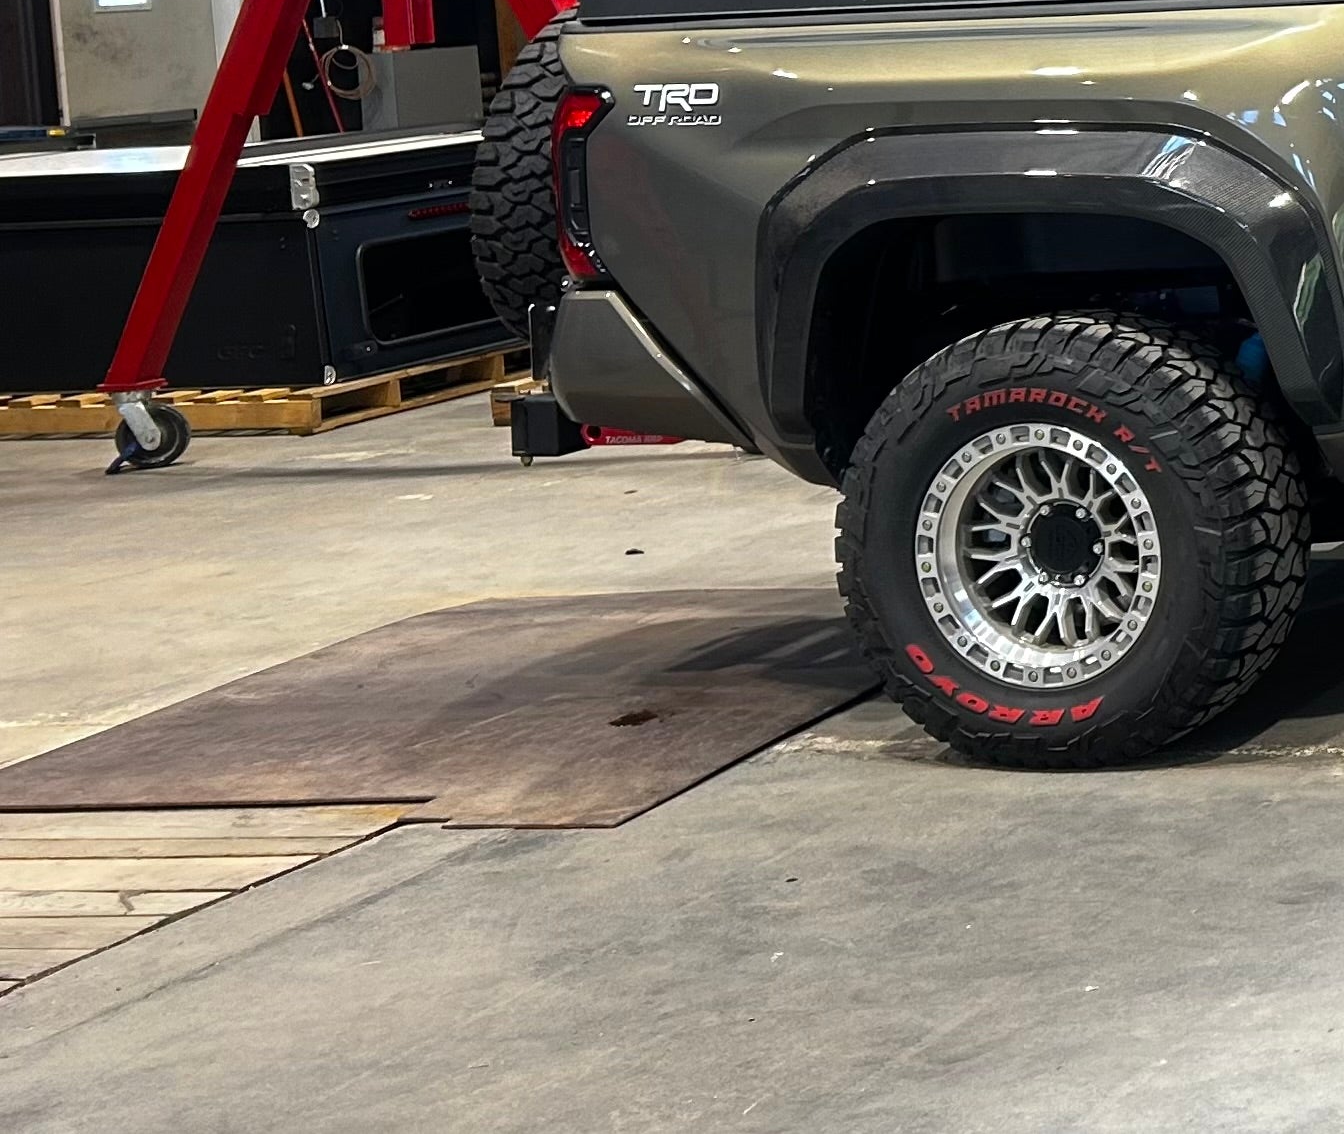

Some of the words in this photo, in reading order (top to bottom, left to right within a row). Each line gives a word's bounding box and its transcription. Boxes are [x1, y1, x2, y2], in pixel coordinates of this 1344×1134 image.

[627, 115, 667, 126] OFF
[668, 114, 722, 126] ROAD
[633, 83, 719, 112] TRD
[946, 387, 1108, 423] TAMAROCK
[1113, 423, 1162, 473] R/T
[905, 642, 1105, 727] ARROYO
